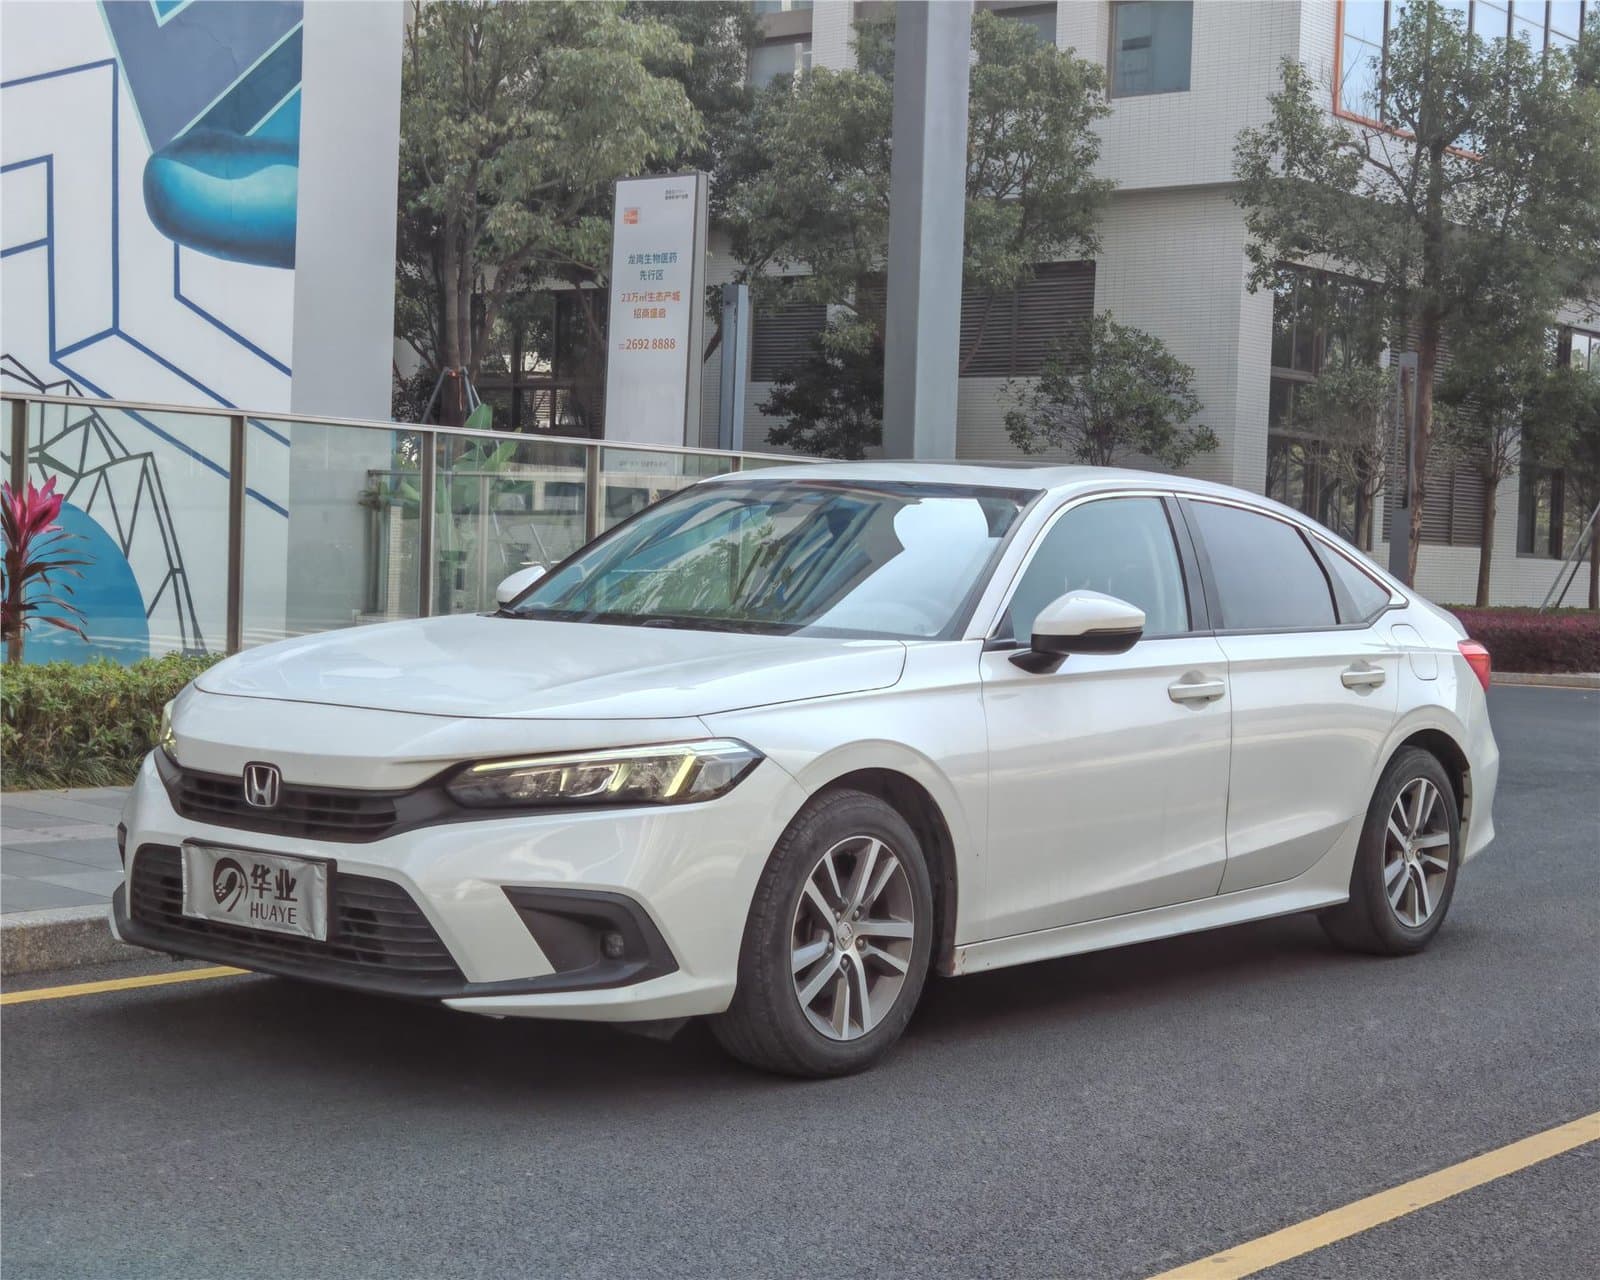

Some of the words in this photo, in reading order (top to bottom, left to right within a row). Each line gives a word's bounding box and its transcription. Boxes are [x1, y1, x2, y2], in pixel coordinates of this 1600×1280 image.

[640, 269, 664, 281] 先行区
[626, 338, 649, 350] 2692
[652, 337, 676, 350] 8888
[251, 863, 298, 902] 华业
[251, 903, 297, 925] HUAYE
